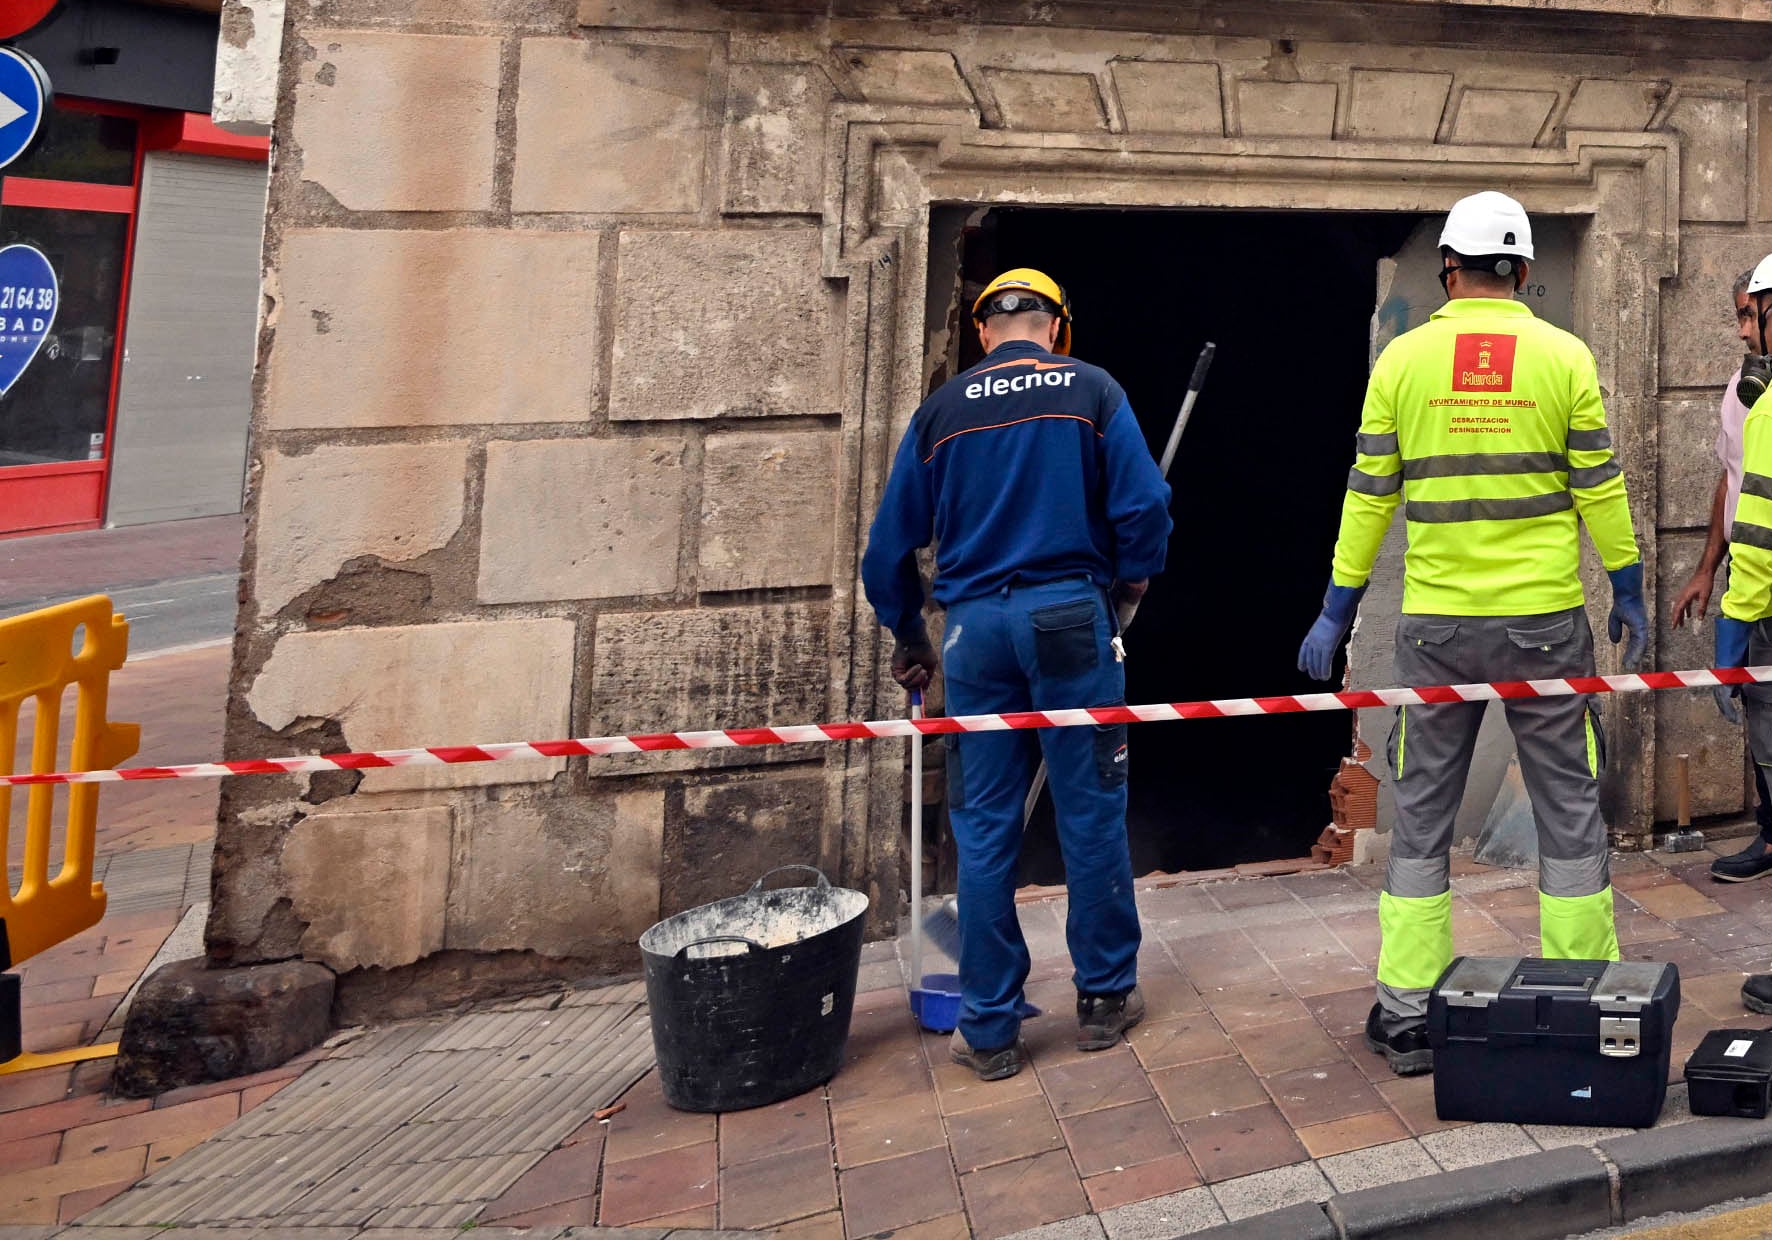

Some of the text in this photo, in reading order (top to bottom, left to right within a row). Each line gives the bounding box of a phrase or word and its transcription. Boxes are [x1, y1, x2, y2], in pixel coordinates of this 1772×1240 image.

[1, 286, 53, 311] 21 64 38
[965, 371, 1076, 399] elecnor
[1462, 371, 1503, 386] Murcia
[1429, 398, 1490, 407] AYUNTAMIENTO
[1505, 399, 1537, 407] MURCIA
